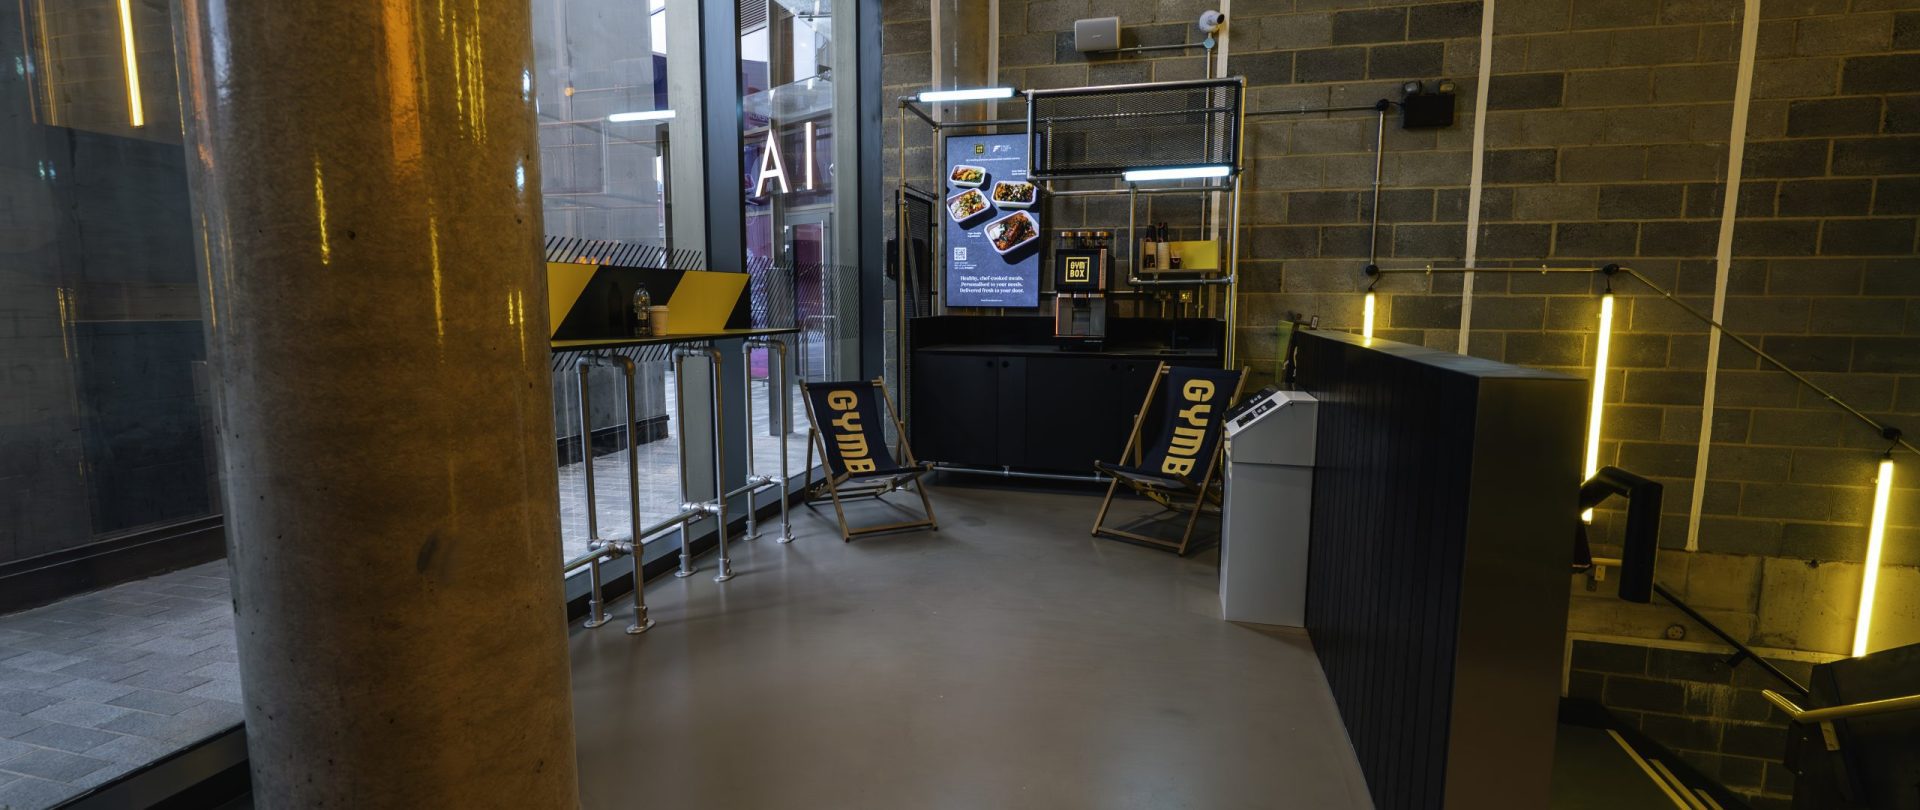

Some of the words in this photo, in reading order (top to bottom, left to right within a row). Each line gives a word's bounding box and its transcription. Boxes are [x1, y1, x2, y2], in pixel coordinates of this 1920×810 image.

[1069, 269, 1085, 278] BOX
[1070, 261, 1086, 269] GYM
[828, 390, 876, 473] GYMB
[1162, 379, 1215, 476] GYMB
